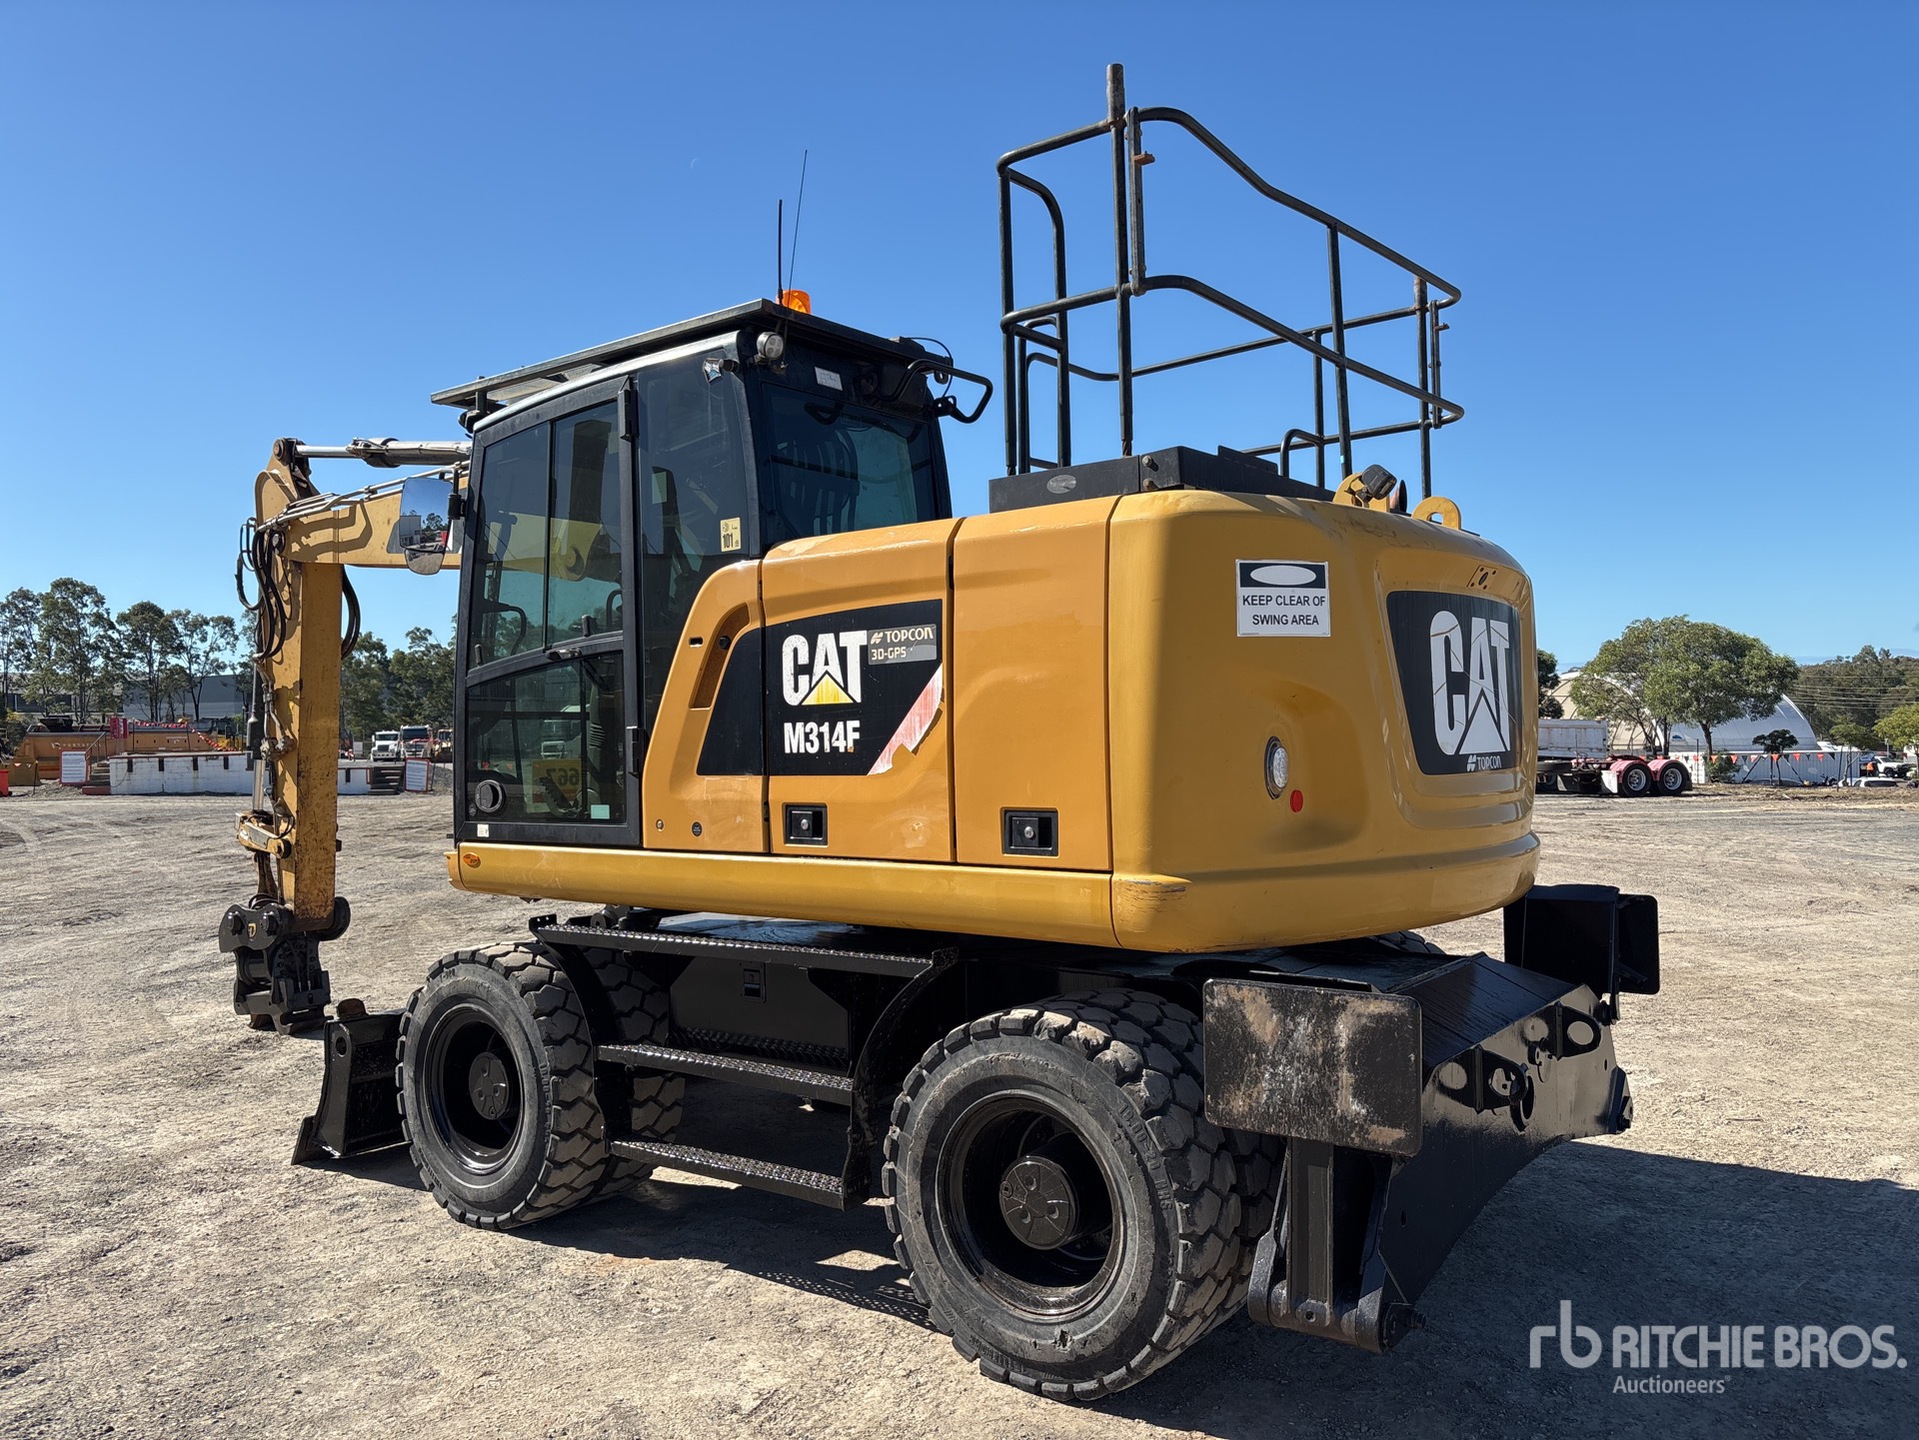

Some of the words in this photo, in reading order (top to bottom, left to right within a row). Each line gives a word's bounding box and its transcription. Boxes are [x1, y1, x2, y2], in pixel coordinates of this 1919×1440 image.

[722, 532, 734, 549] 101
[1242, 594, 1273, 606] KEEP
[1275, 594, 1311, 607] CLEAR
[1312, 595, 1326, 607] OF
[1252, 614, 1289, 626] SWING
[1290, 614, 1320, 626] AREA
[884, 627, 934, 643] TOPCON
[871, 646, 907, 661] 3D-GPS
[782, 630, 868, 706] CAT
[1429, 610, 1511, 756] CAT
[783, 720, 861, 754] M314F
[1476, 755, 1502, 770] TOPCON
